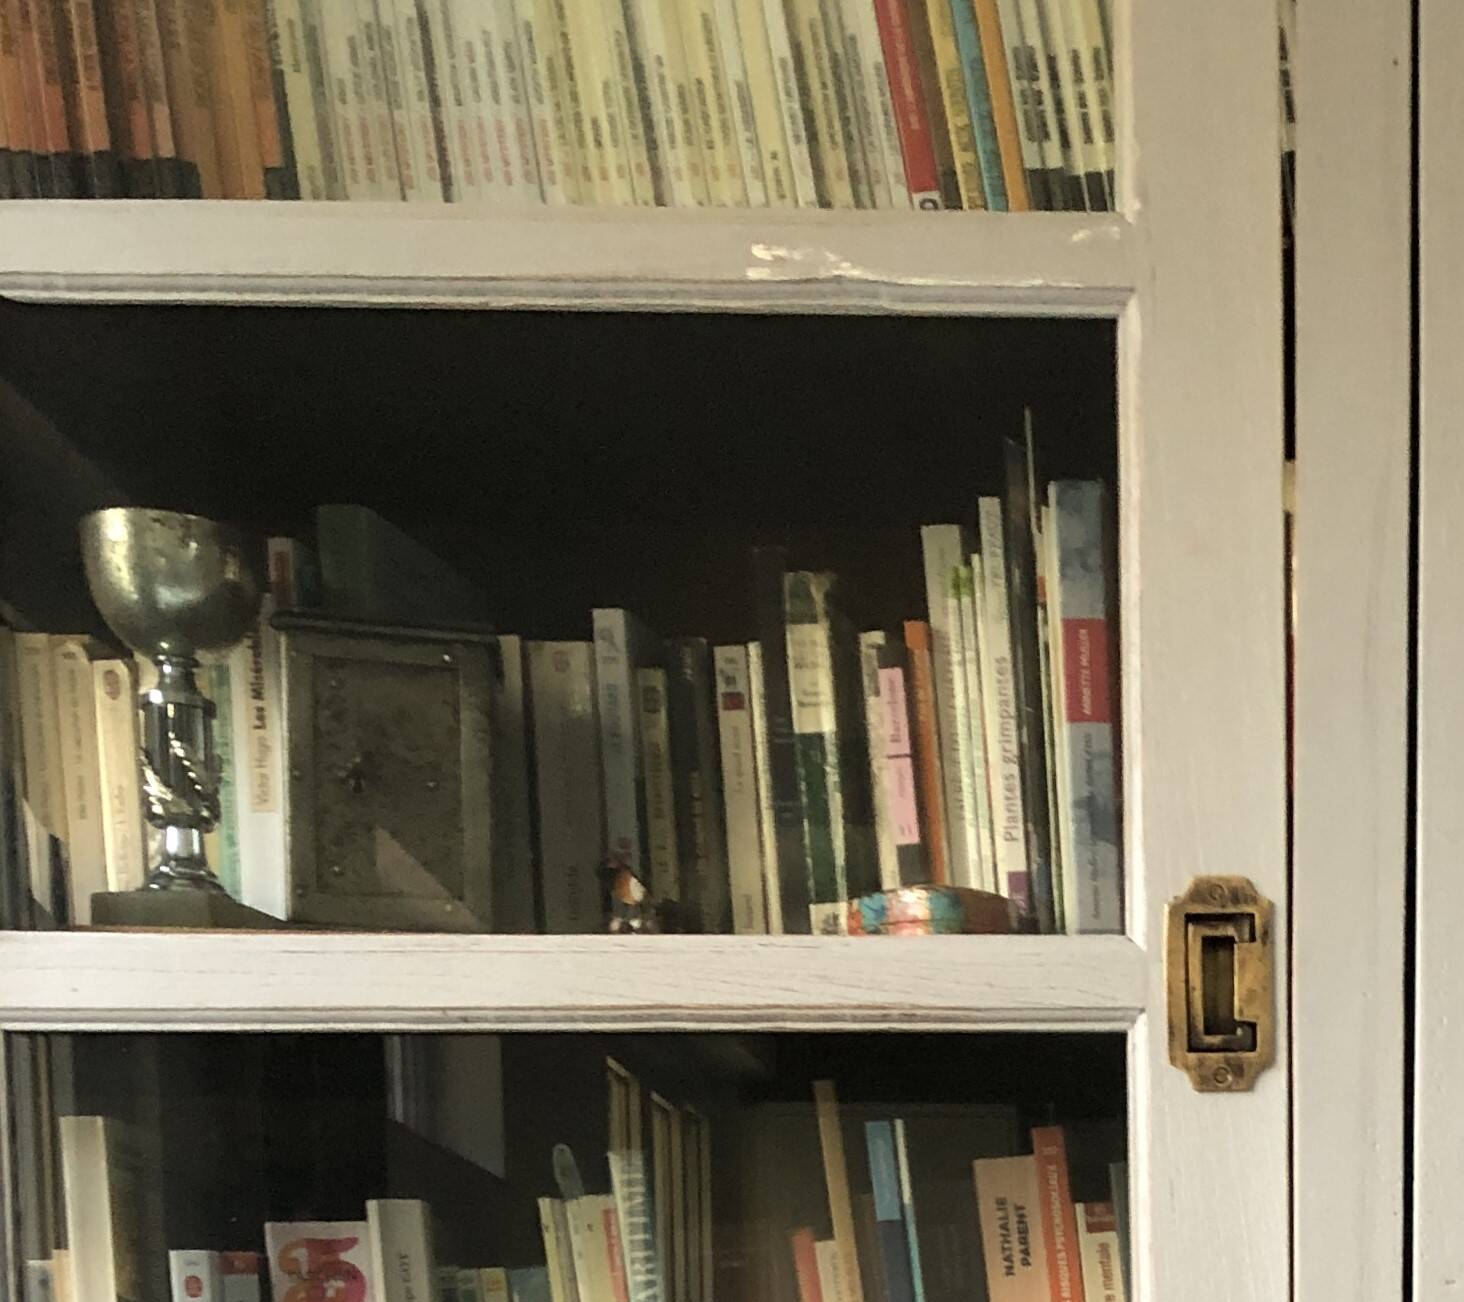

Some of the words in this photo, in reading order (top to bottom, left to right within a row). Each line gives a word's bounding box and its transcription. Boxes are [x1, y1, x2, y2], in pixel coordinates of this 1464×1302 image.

[995, 656, 1018, 765] grimpantes
[1002, 772, 1021, 842] Plantes
[995, 1198, 1016, 1278] NATHALIE
[1013, 1204, 1033, 1268] PARENT
[1096, 1243, 1115, 1290] mentale
[1056, 1251, 1072, 1298] RISQUES
